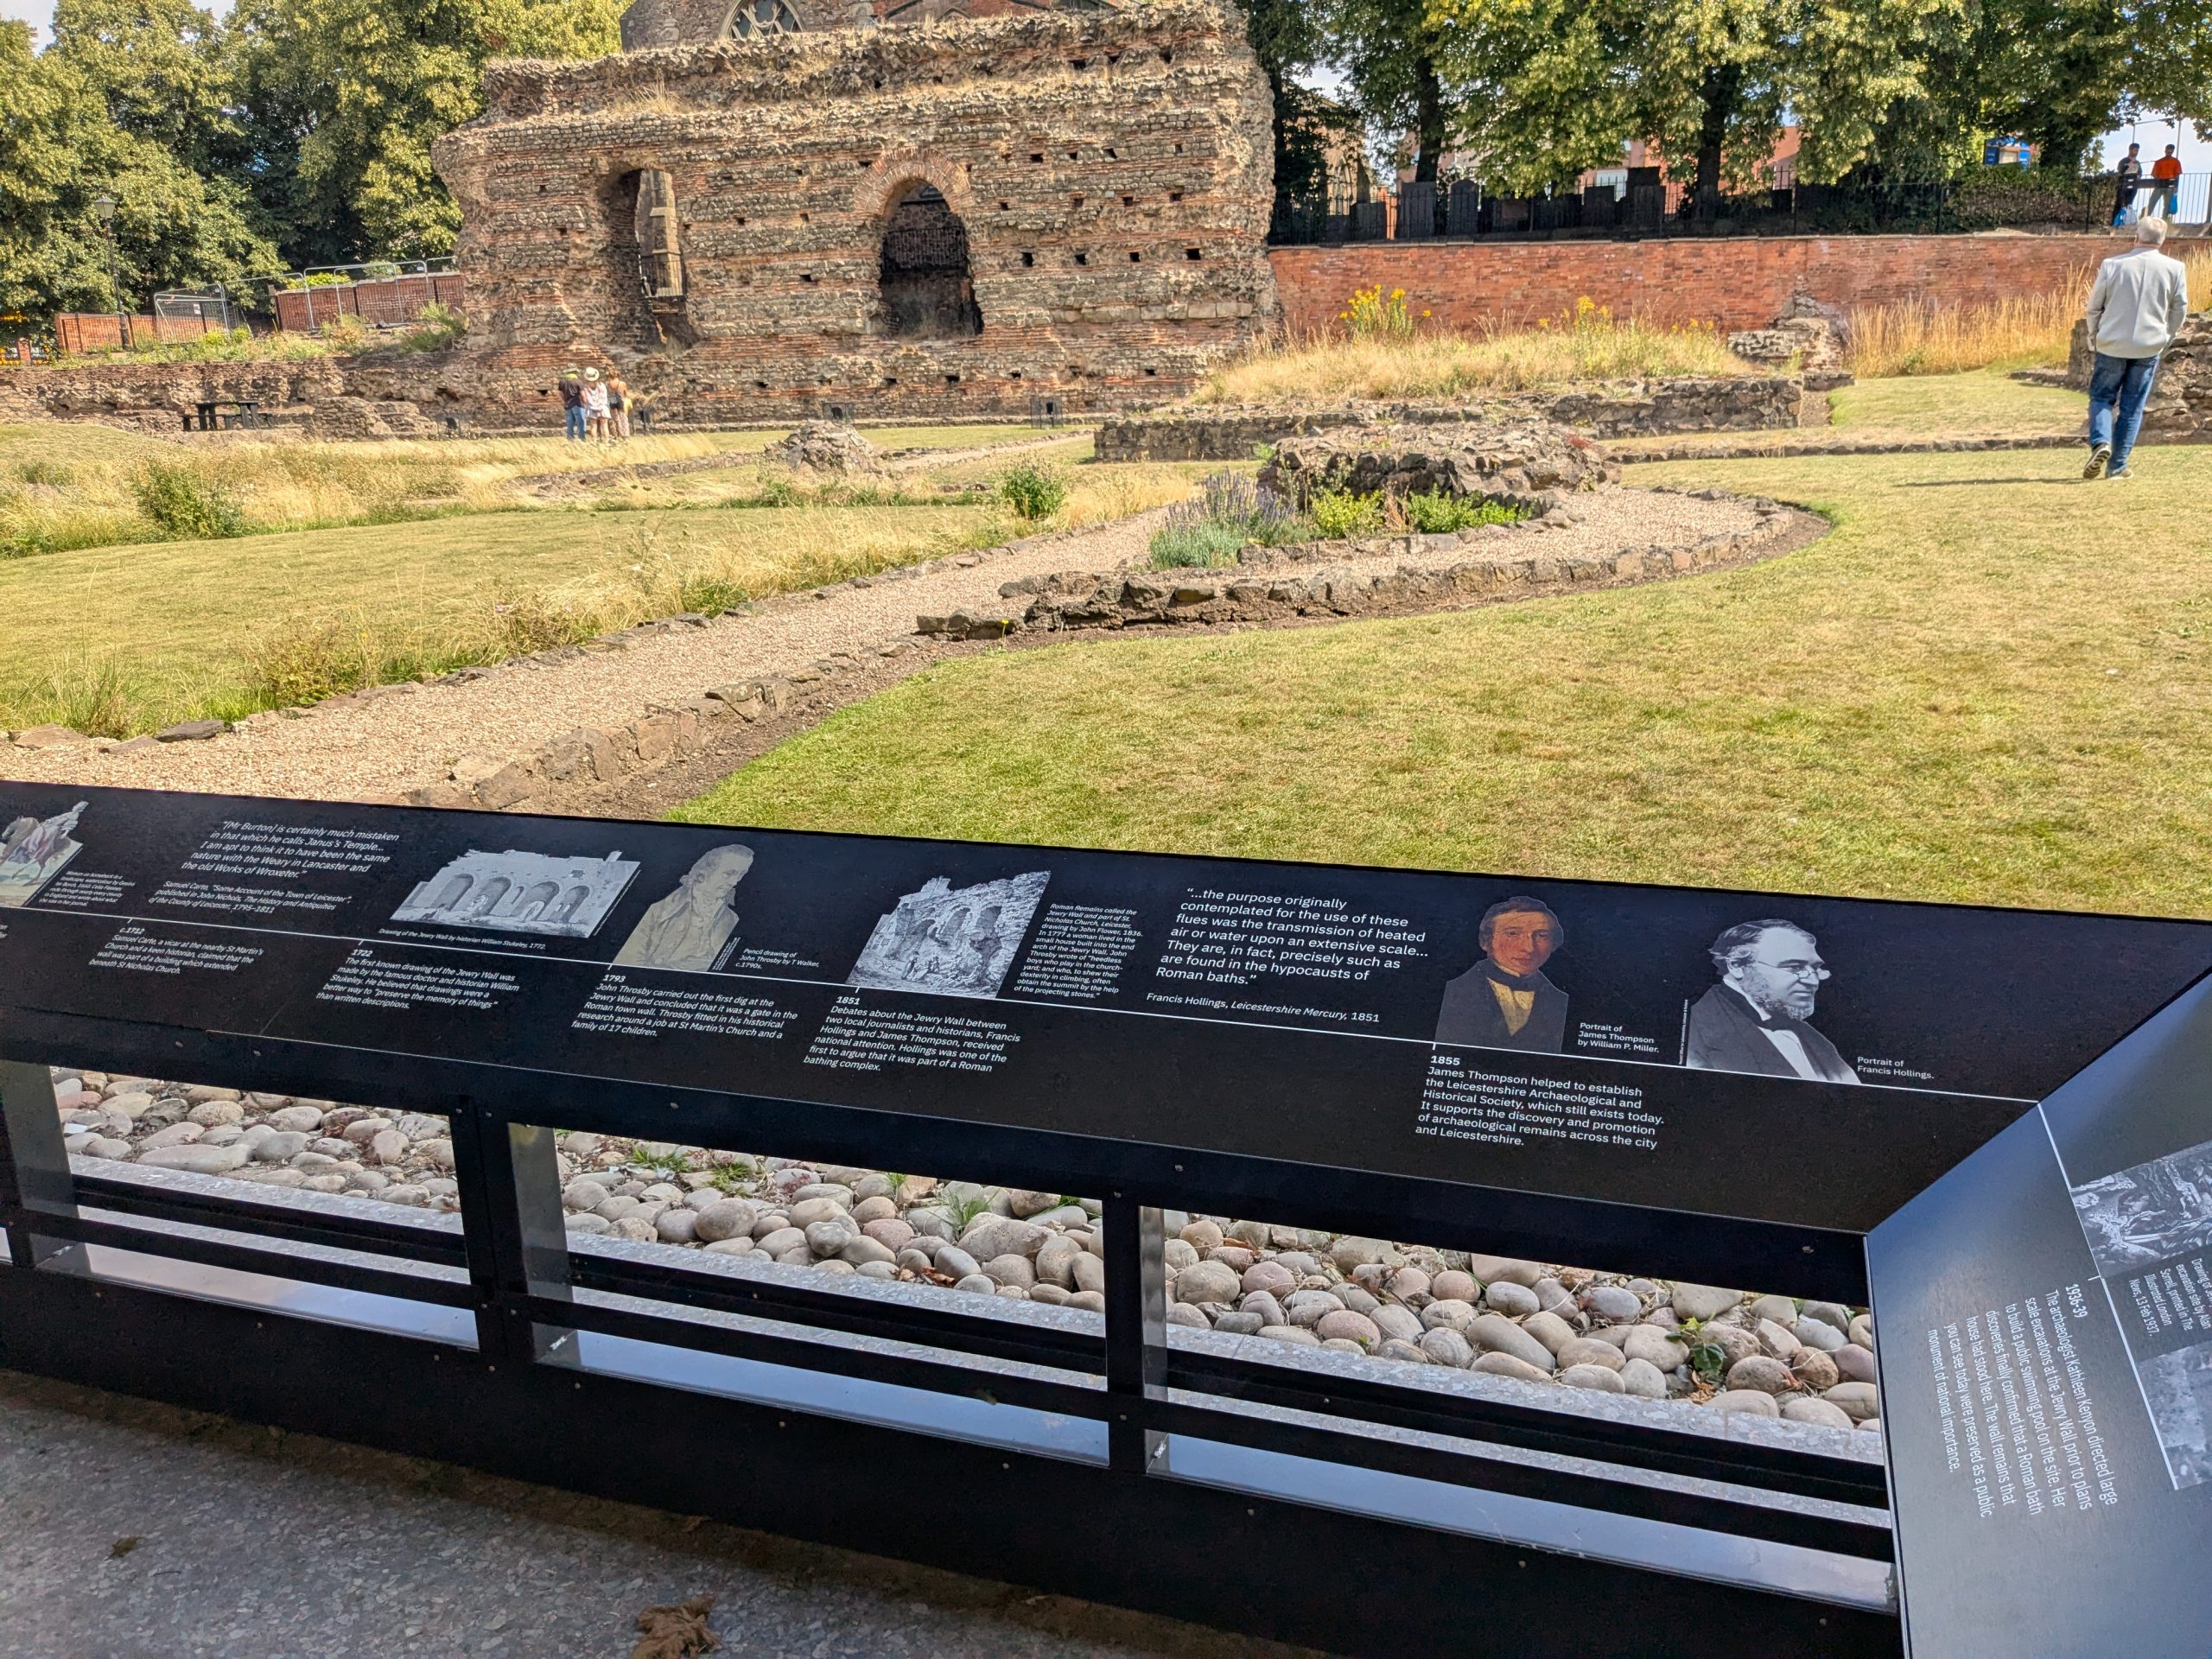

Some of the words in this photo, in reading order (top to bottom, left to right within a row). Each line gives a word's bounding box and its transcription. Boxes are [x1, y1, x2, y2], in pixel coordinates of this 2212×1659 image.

[240, 822, 278, 833] Burton]
[276, 824, 286, 833] is
[285, 827, 327, 837] certainly
[326, 829, 354, 837] much
[354, 831, 400, 841] mistaken
[1180, 902, 1273, 916] contemplated
[1276, 907, 1295, 918] for
[1298, 909, 1320, 920] the
[1324, 913, 1349, 922] use
[1351, 913, 1367, 924] of
[1370, 914, 1408, 927] these
[1226, 893, 1281, 904] purpose
[1284, 895, 1347, 911] originally
[1175, 912, 1208, 925] flues
[1211, 918, 1237, 927] was
[1241, 918, 1263, 929] the
[1267, 921, 1354, 937] transmission
[1357, 928, 1374, 938] of
[1376, 928, 1426, 942] heated
[763, 950, 789, 958] drawing
[1167, 939, 1199, 953] They
[1201, 944, 1226, 955] are,
[1230, 944, 1243, 955] in
[1246, 945, 1275, 959] fact,
[1279, 951, 1344, 966] precisely
[1346, 956, 1380, 967] such
[1383, 960, 1401, 969] as
[1170, 926, 1189, 937] air
[1191, 930, 1206, 938] or
[1209, 931, 1248, 941] water
[1249, 935, 1284, 945] upon
[1287, 938, 1305, 946] an
[1308, 939, 1376, 952] extensive
[1378, 944, 1428, 957] scale...
[88, 958, 118, 967] beneath
[124, 962, 155, 971] Nicholas
[359, 958, 376, 967] first
[375, 960, 402, 969] known
[401, 963, 434, 974] drawing
[455, 969, 480, 979] Jewry
[480, 971, 499, 980] Wall
[756, 956, 782, 964] Throsby
[797, 959, 819, 968] Walker,
[1155, 966, 1204, 980] Roman
[1160, 955, 1183, 964] are
[1185, 955, 1226, 968] found
[1228, 958, 1241, 969] in
[1244, 960, 1267, 971] the
[1270, 962, 1351, 979] hypocausts
[1354, 969, 1370, 981] of
[602, 974, 626, 982] 1793
[595, 982, 618, 992] John
[619, 985, 652, 996] Throsby
[652, 989, 684, 998] carried
[699, 993, 715, 1001] the
[715, 994, 734, 1003] first
[733, 996, 748, 1006] dig
[759, 998, 774, 1007] the
[836, 995, 860, 1005] 1851
[1146, 992, 1183, 1003] Francis
[1185, 996, 1228, 1008] Hollings,
[1230, 1001, 1301, 1014] Leicestershire
[1302, 1007, 1347, 1020] Mercury,
[1351, 1012, 1379, 1022] 1851
[825, 1015, 842, 1024] two
[843, 1016, 867, 1027] local
[865, 1019, 915, 1031] journalists
[935, 1026, 983, 1039] historians,
[985, 1031, 1020, 1042] Francis
[830, 1005, 868, 1016] Debates
[868, 1009, 896, 1019] about
[897, 1012, 912, 1020] the
[913, 1013, 943, 1025] Jewry
[944, 1016, 965, 1026] Wall
[965, 1018, 1007, 1030] between
[1580, 1022, 1611, 1031] Portrait
[1577, 1038, 1588, 1046] by
[1590, 1039, 1622, 1049] William
[1633, 1044, 1659, 1052] Miller.
[1578, 1030, 1607, 1039] James
[1609, 1033, 1655, 1044] Thompson
[1430, 1055, 1460, 1065] 1855
[1857, 1056, 1892, 1066] Portrait
[1857, 1065, 1891, 1075] Francis
[1893, 1068, 1935, 1079] Hollings.
[1426, 1077, 1444, 1087] the
[1446, 1079, 1527, 1096] Leicestershire
[1529, 1089, 1616, 1106] Archaeological
[1618, 1099, 1642, 1109] and
[1427, 1066, 1465, 1078] James
[1467, 1070, 1528, 1084] Thompson
[1530, 1077, 1571, 1089] helped
[1573, 1082, 1586, 1090] to
[1588, 1084, 1642, 1096] establish
[1421, 1101, 1431, 1109] It
[1433, 1103, 1484, 1116] supports
[1486, 1108, 1505, 1118] the
[1508, 1110, 1565, 1127] discovery
[1567, 1118, 1590, 1128] and
[1592, 1122, 1656, 1135] promotion
[1423, 1089, 1477, 1103] Historical
[1479, 1095, 1524, 1109] Society,
[1528, 1101, 1562, 1112] which
[1565, 1105, 1586, 1116] still
[1589, 1108, 1624, 1119] exists
[1627, 1111, 1664, 1125] today.
[1414, 1126, 1438, 1135] and
[1440, 1127, 1524, 1146] Leicestershire.
[1418, 1113, 1430, 1122] of
[1432, 1116, 1516, 1132] archaeological
[1518, 1126, 1567, 1138] remains
[1569, 1131, 1609, 1142] across
[1611, 1135, 1632, 1145] the
[1635, 1137, 1657, 1150] city
[2045, 1288, 2060, 1306] The
[2065, 1283, 2088, 1318] 1936-39
[2049, 1306, 2076, 1360] archaeologist
[1928, 1329, 1946, 1372] monument
[1934, 1372, 1948, 1382] of
[2065, 1358, 2086, 1400] Kathleen
[1936, 1382, 1954, 1417] national
[2076, 1398, 2097, 1435] Kenyon
[1941, 1417, 1961, 1472] importance.
[2087, 1435, 2113, 1478] directed
[2099, 1471, 2118, 1505] large
